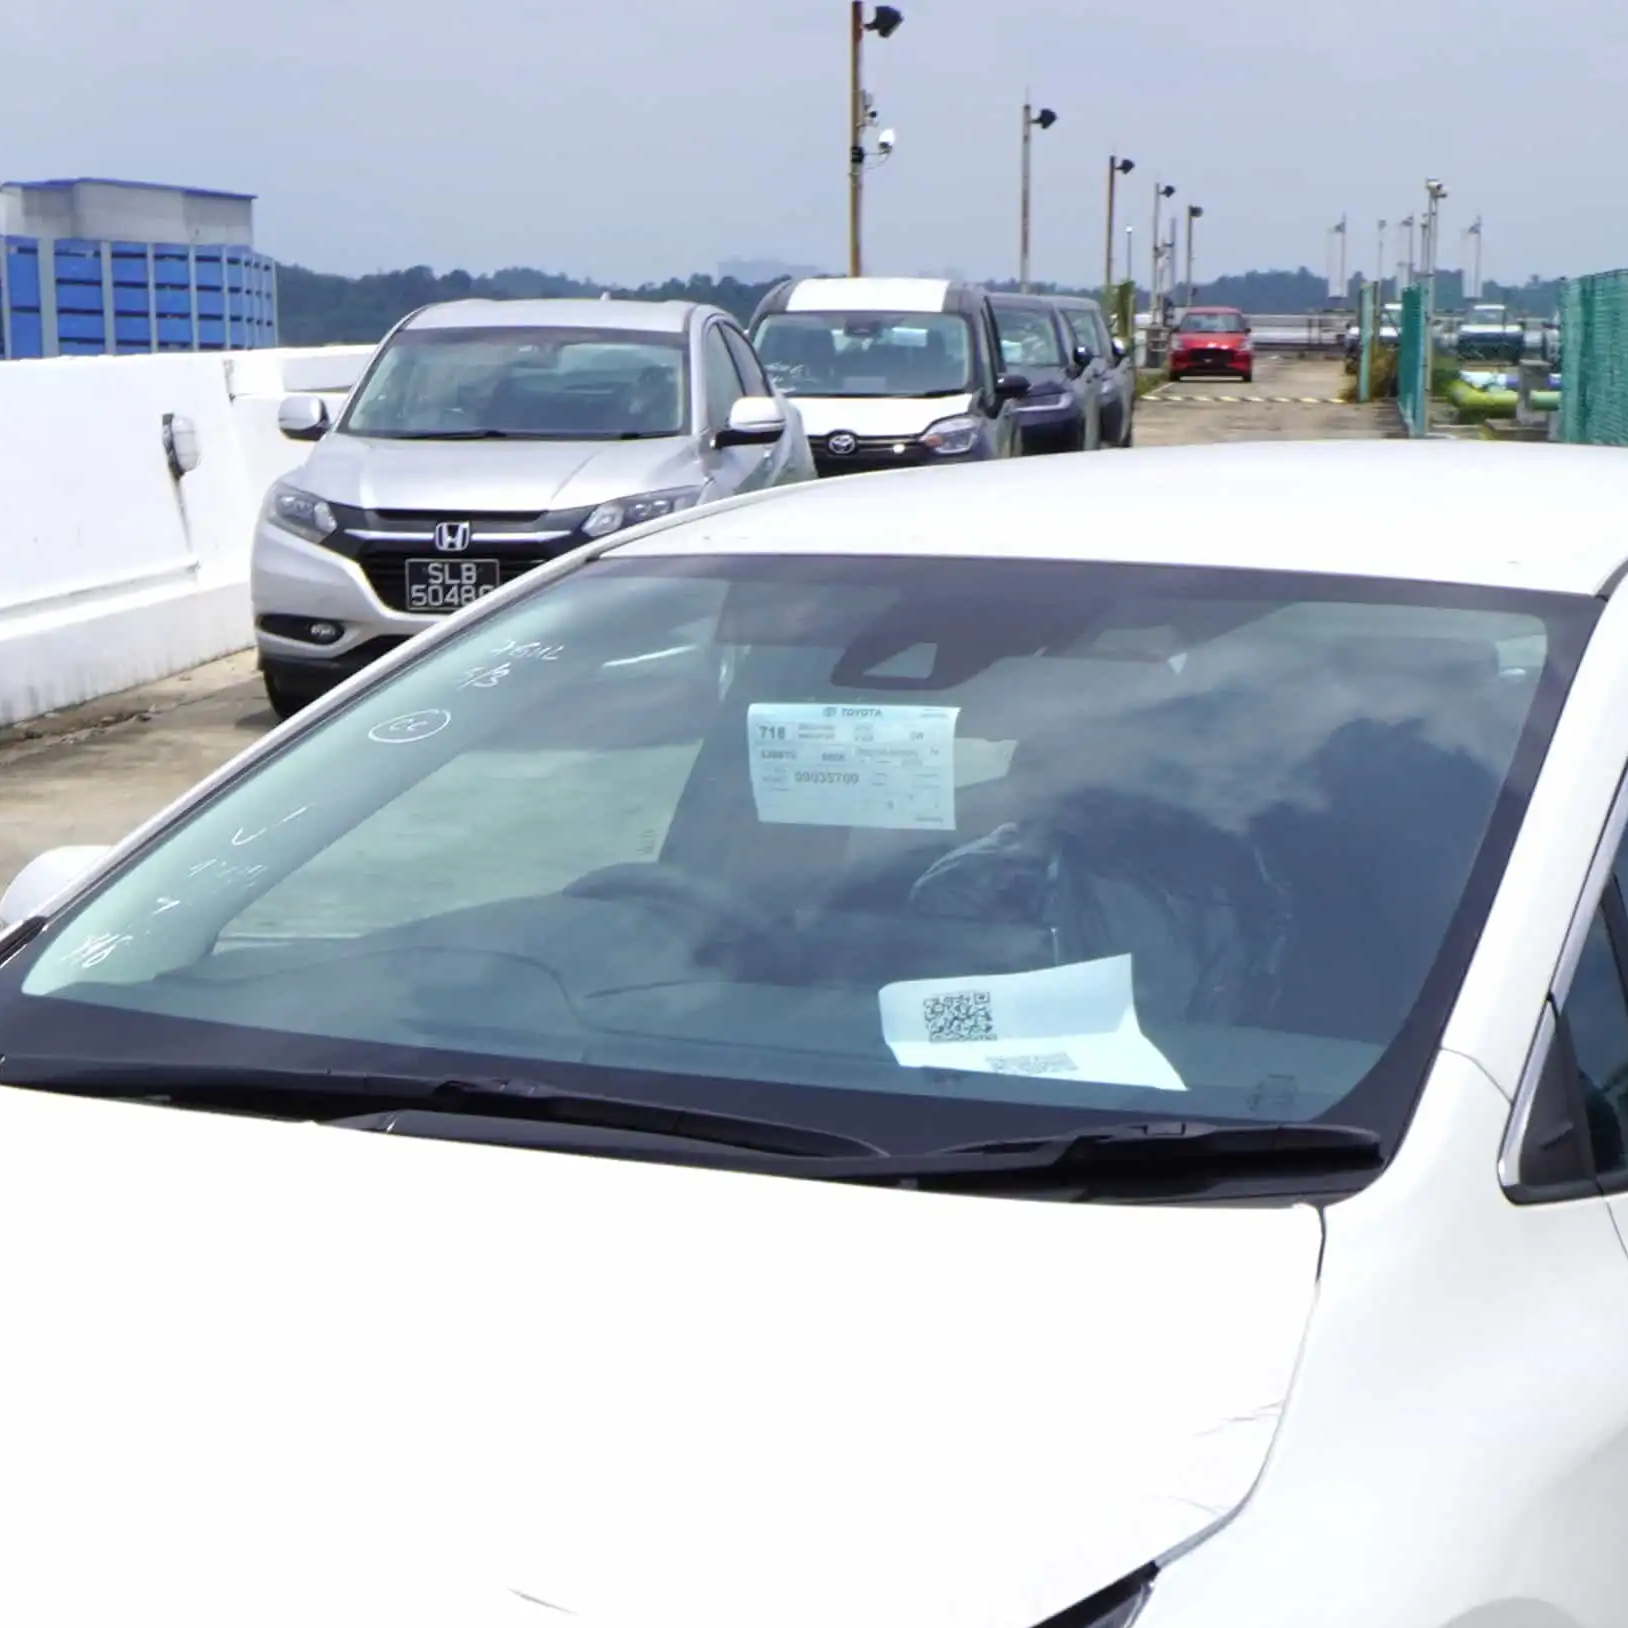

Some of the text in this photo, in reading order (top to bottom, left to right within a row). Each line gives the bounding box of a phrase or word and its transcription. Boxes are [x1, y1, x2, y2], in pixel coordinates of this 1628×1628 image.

[427, 562, 478, 585] SLB
[841, 707, 883, 718] TOYOTA
[758, 726, 786, 740] 718
